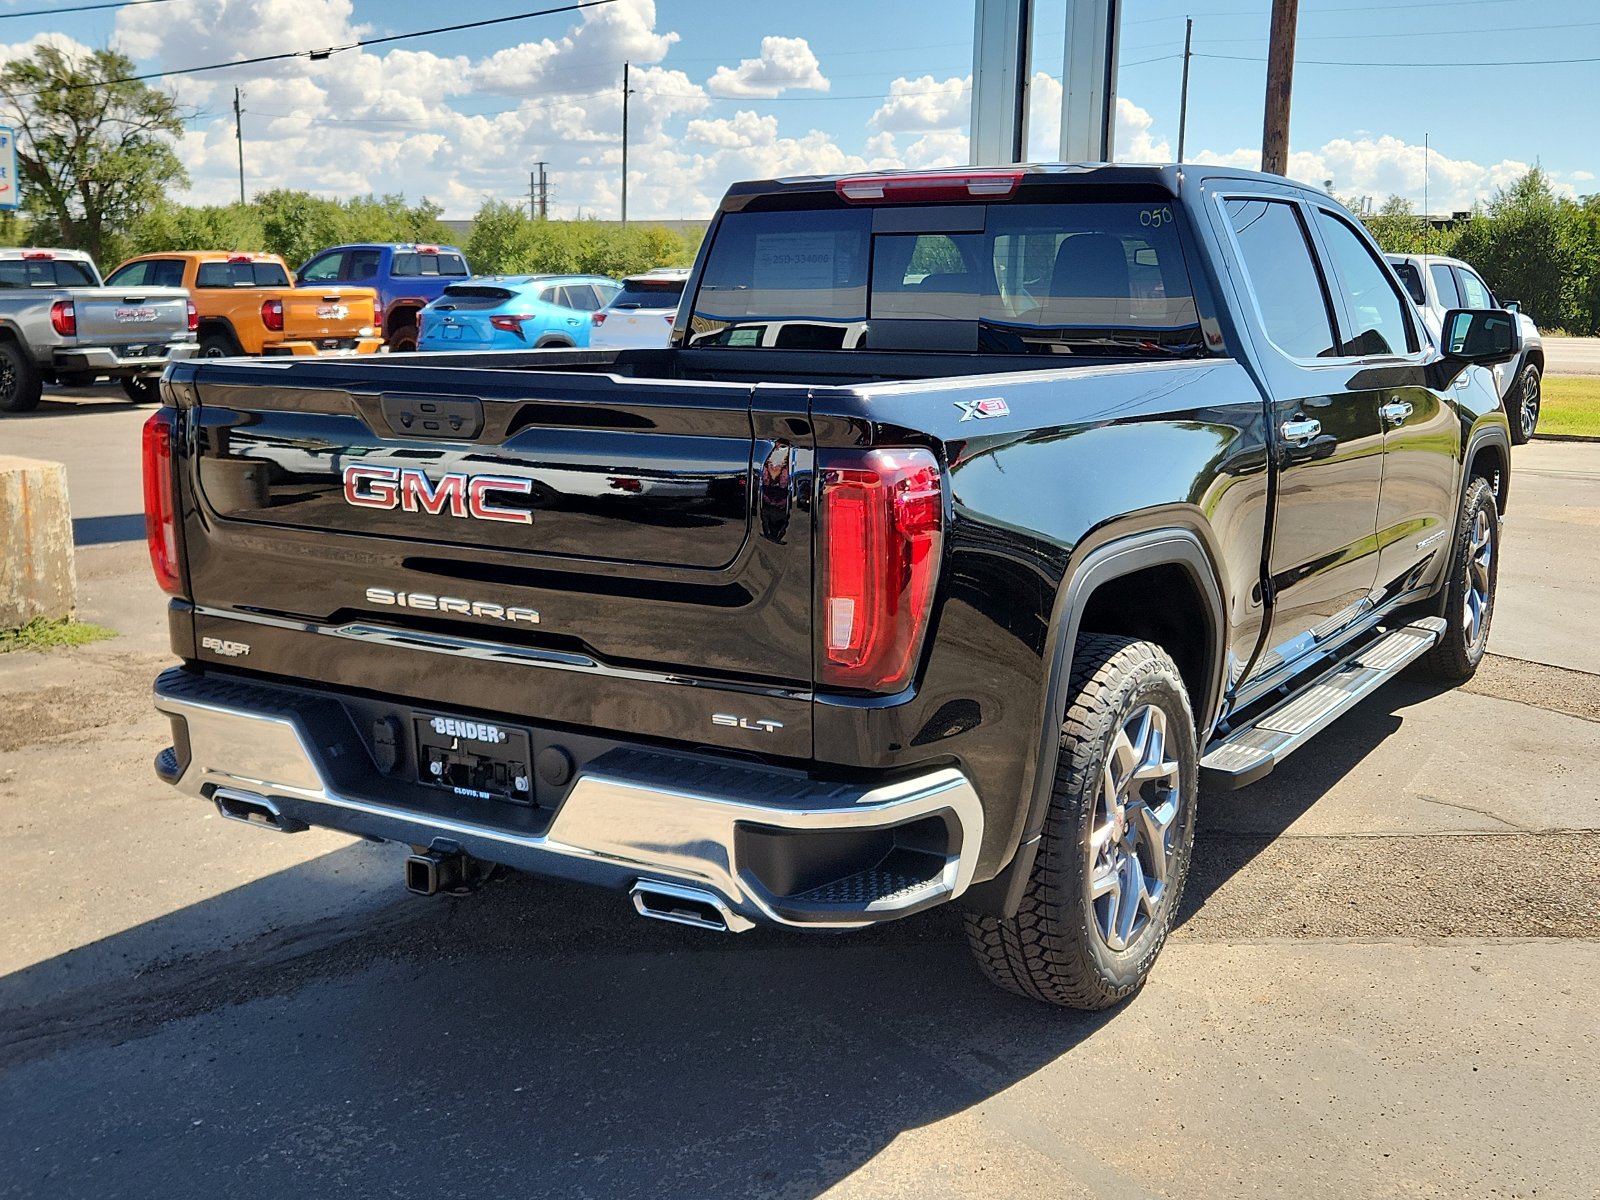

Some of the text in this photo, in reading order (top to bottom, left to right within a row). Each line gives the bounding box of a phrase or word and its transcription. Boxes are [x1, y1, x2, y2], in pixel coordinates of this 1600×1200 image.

[343, 464, 534, 525] GMC
[366, 588, 541, 624] SIERRA
[202, 637, 250, 655] BENDER
[434, 717, 500, 743] BENDER
[712, 713, 784, 733] SLT
